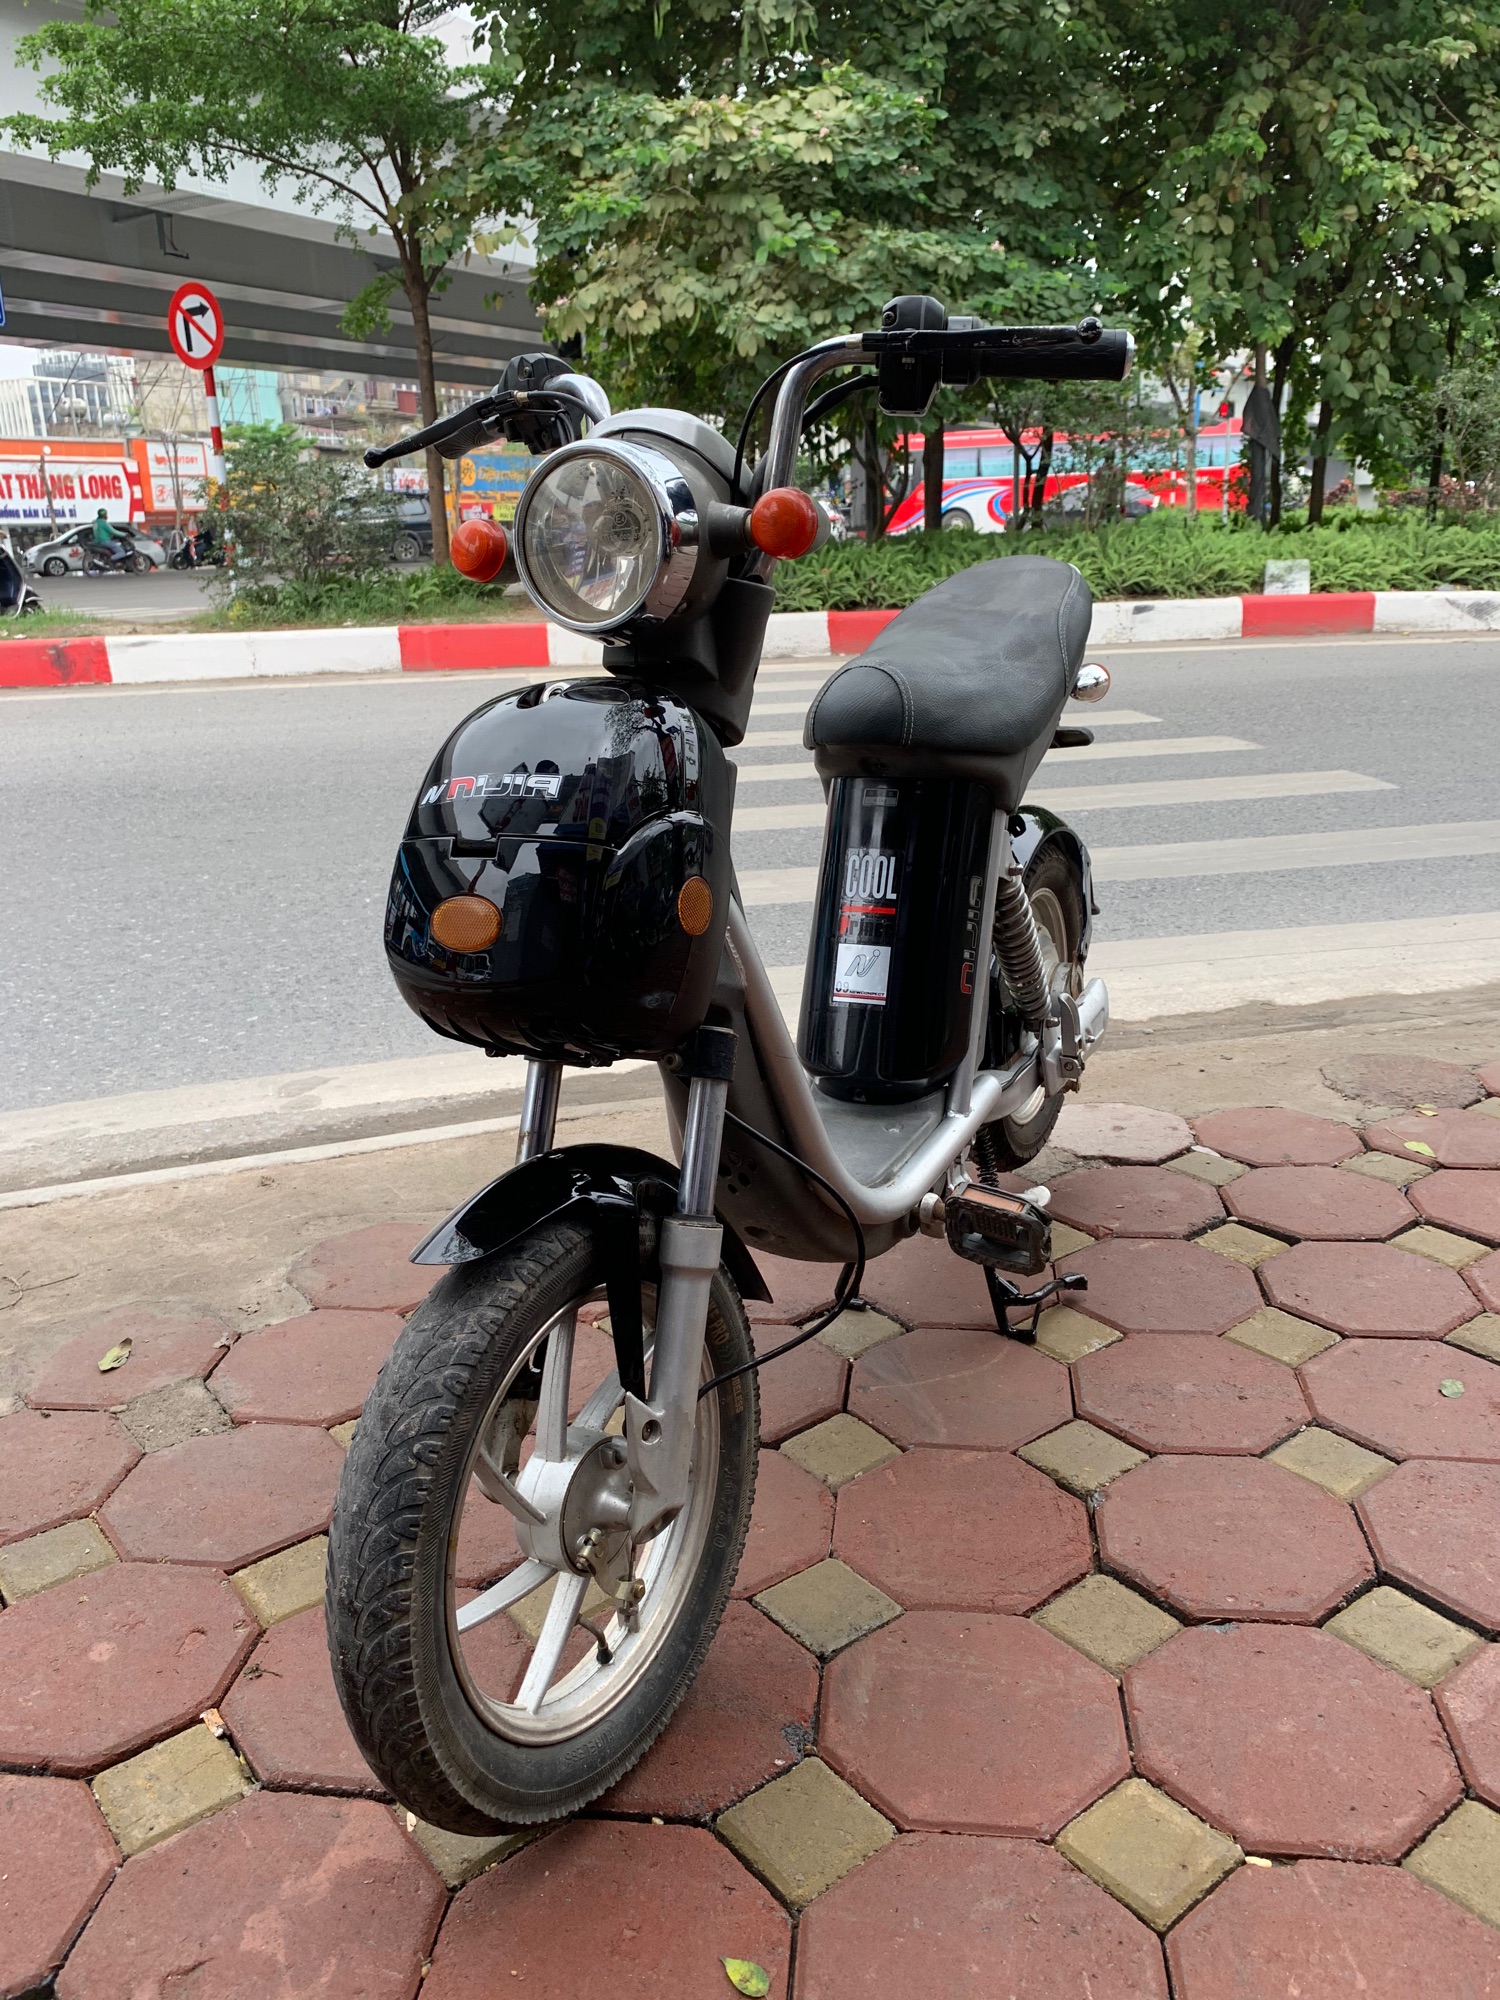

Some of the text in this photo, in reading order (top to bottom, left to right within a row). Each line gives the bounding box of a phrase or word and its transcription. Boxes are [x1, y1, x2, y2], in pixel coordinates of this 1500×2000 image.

[78, 474, 123, 499] LONG
[844, 854, 897, 900] COOL
[709, 1316, 730, 1346] PRO
[731, 1376, 744, 1414] BELESS
